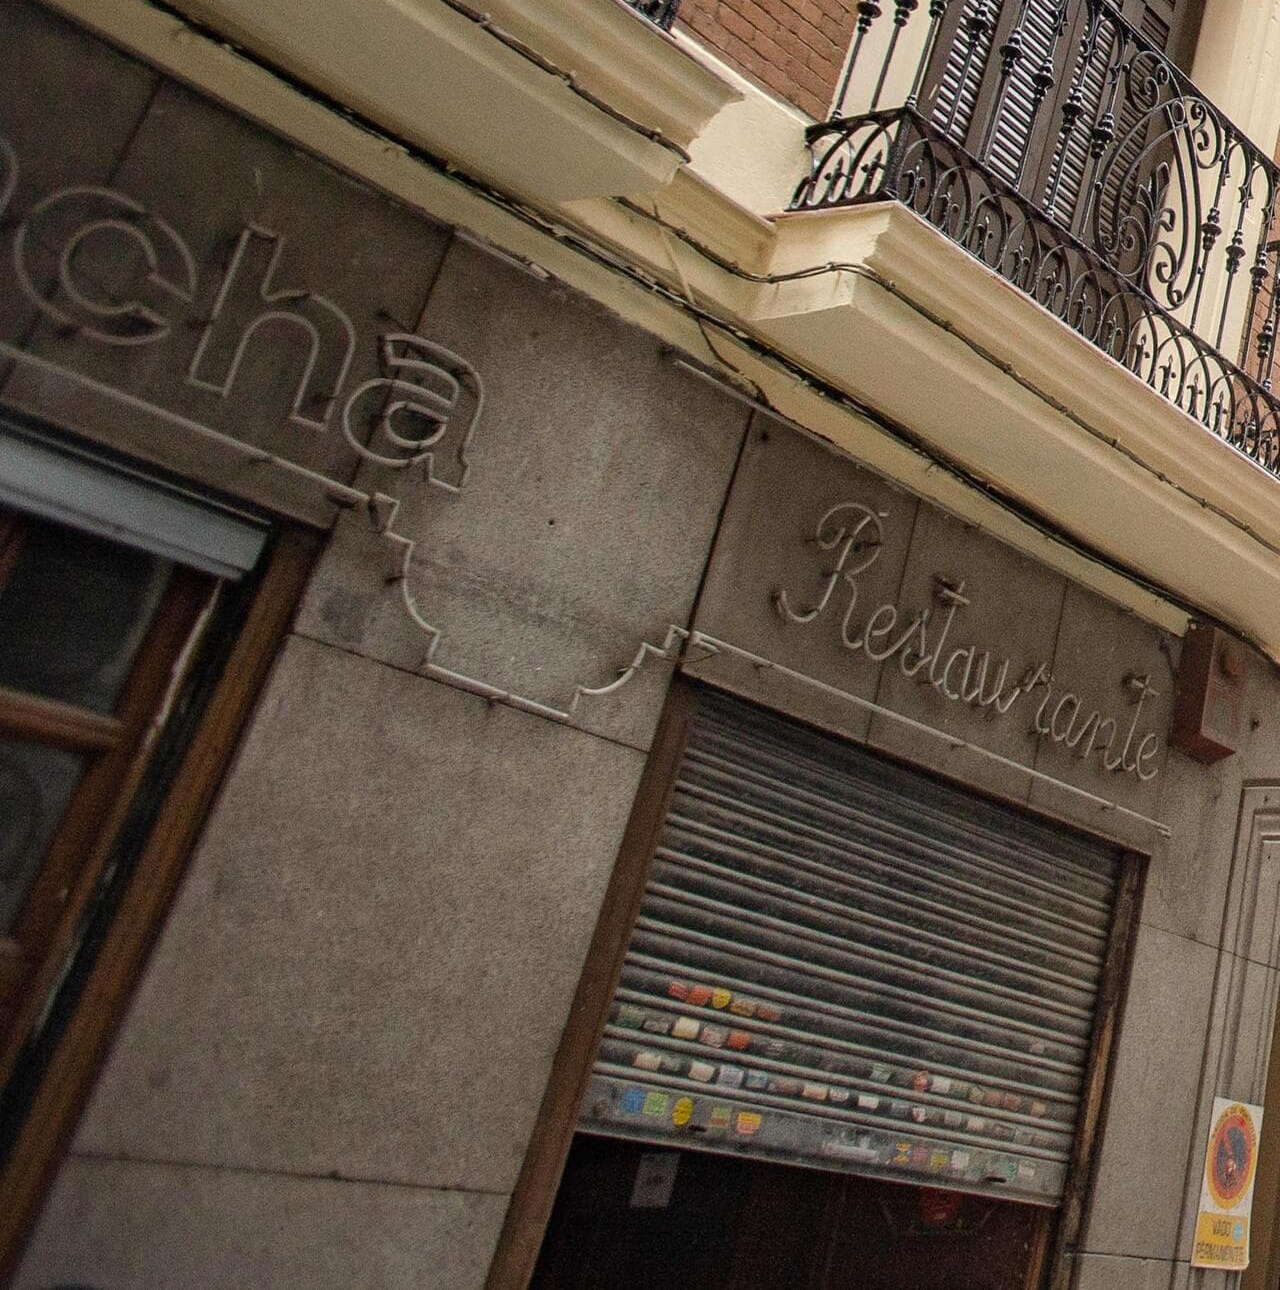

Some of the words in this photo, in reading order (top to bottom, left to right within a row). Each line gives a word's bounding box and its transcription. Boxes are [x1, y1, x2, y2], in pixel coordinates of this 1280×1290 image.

[0, 140, 485, 492] cha
[776, 502, 1161, 781] Restaurante
[1196, 1241, 1245, 1263] PERMANENTE
[1212, 1220, 1232, 1237] VADO
